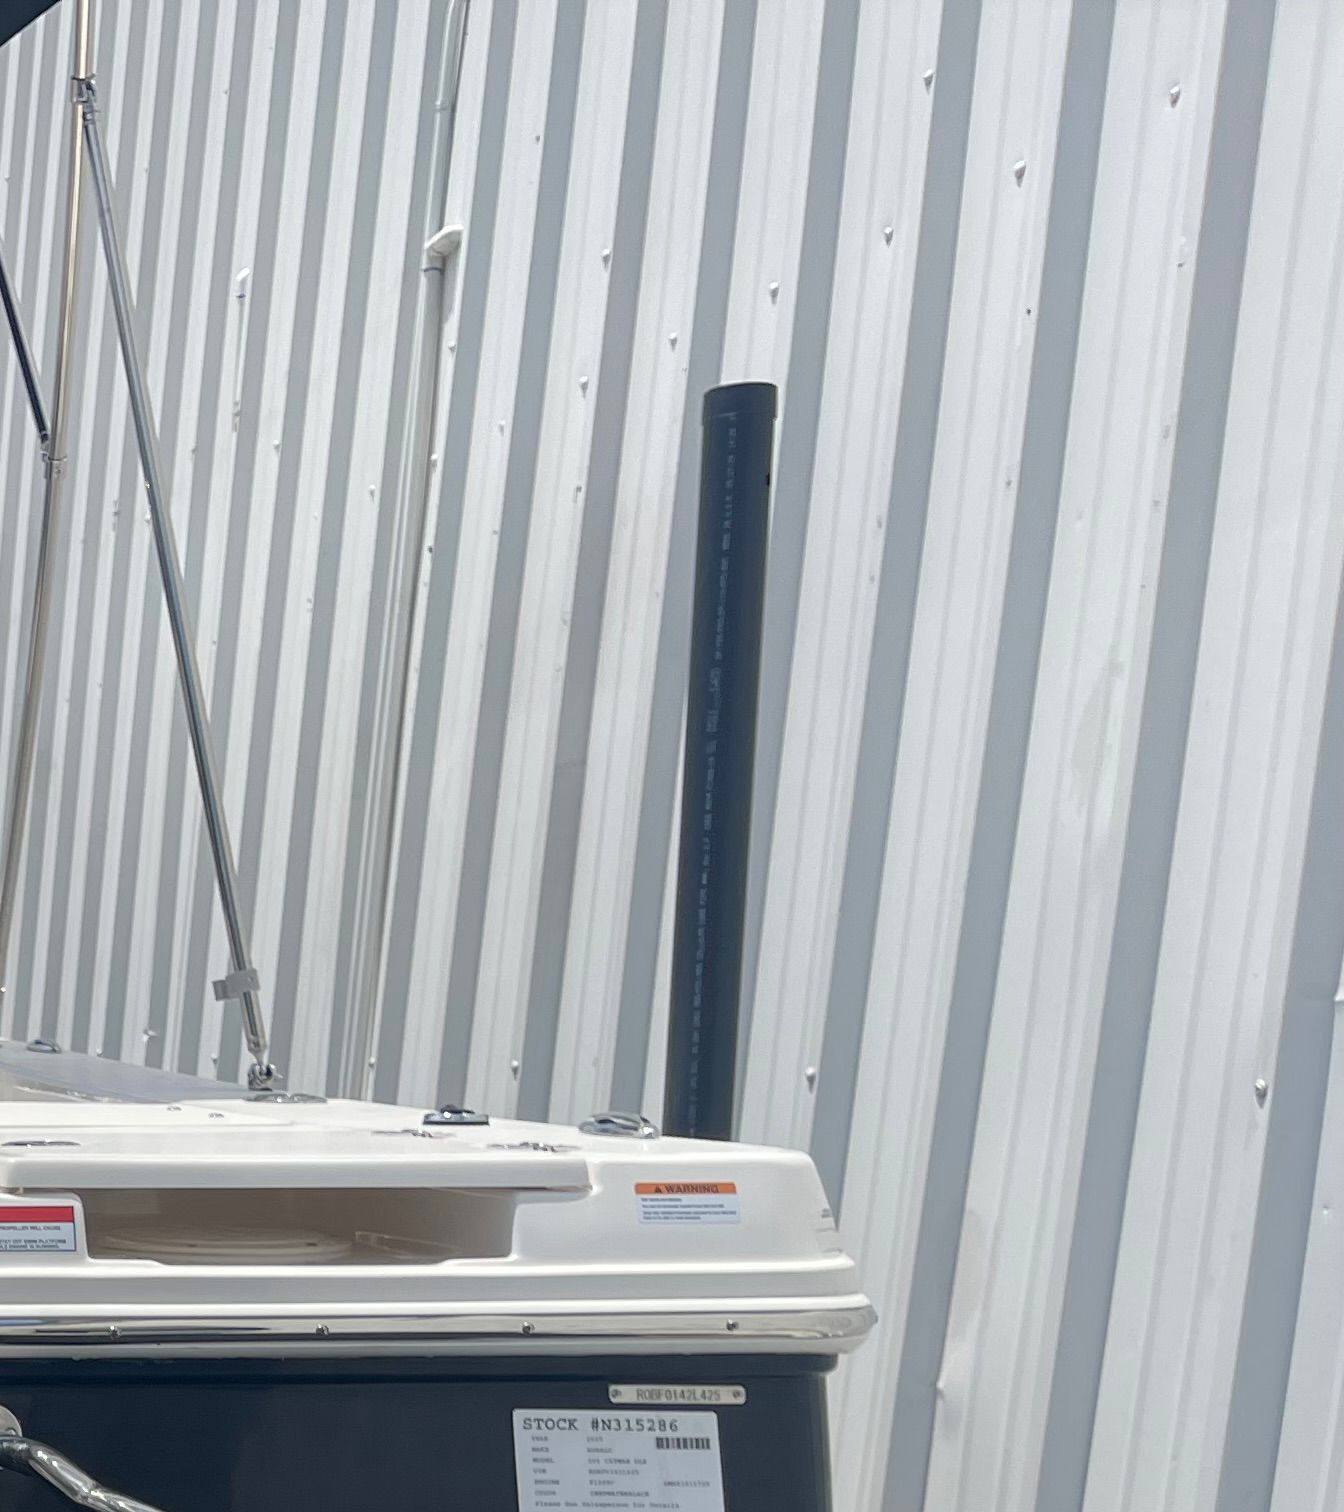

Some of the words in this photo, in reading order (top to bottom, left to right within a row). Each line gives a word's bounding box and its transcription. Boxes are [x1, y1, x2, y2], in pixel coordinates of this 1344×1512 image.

[665, 1183, 720, 1194] WARNING
[522, 1417, 579, 1431] STOCK
[590, 1417, 679, 1433] #N315286
